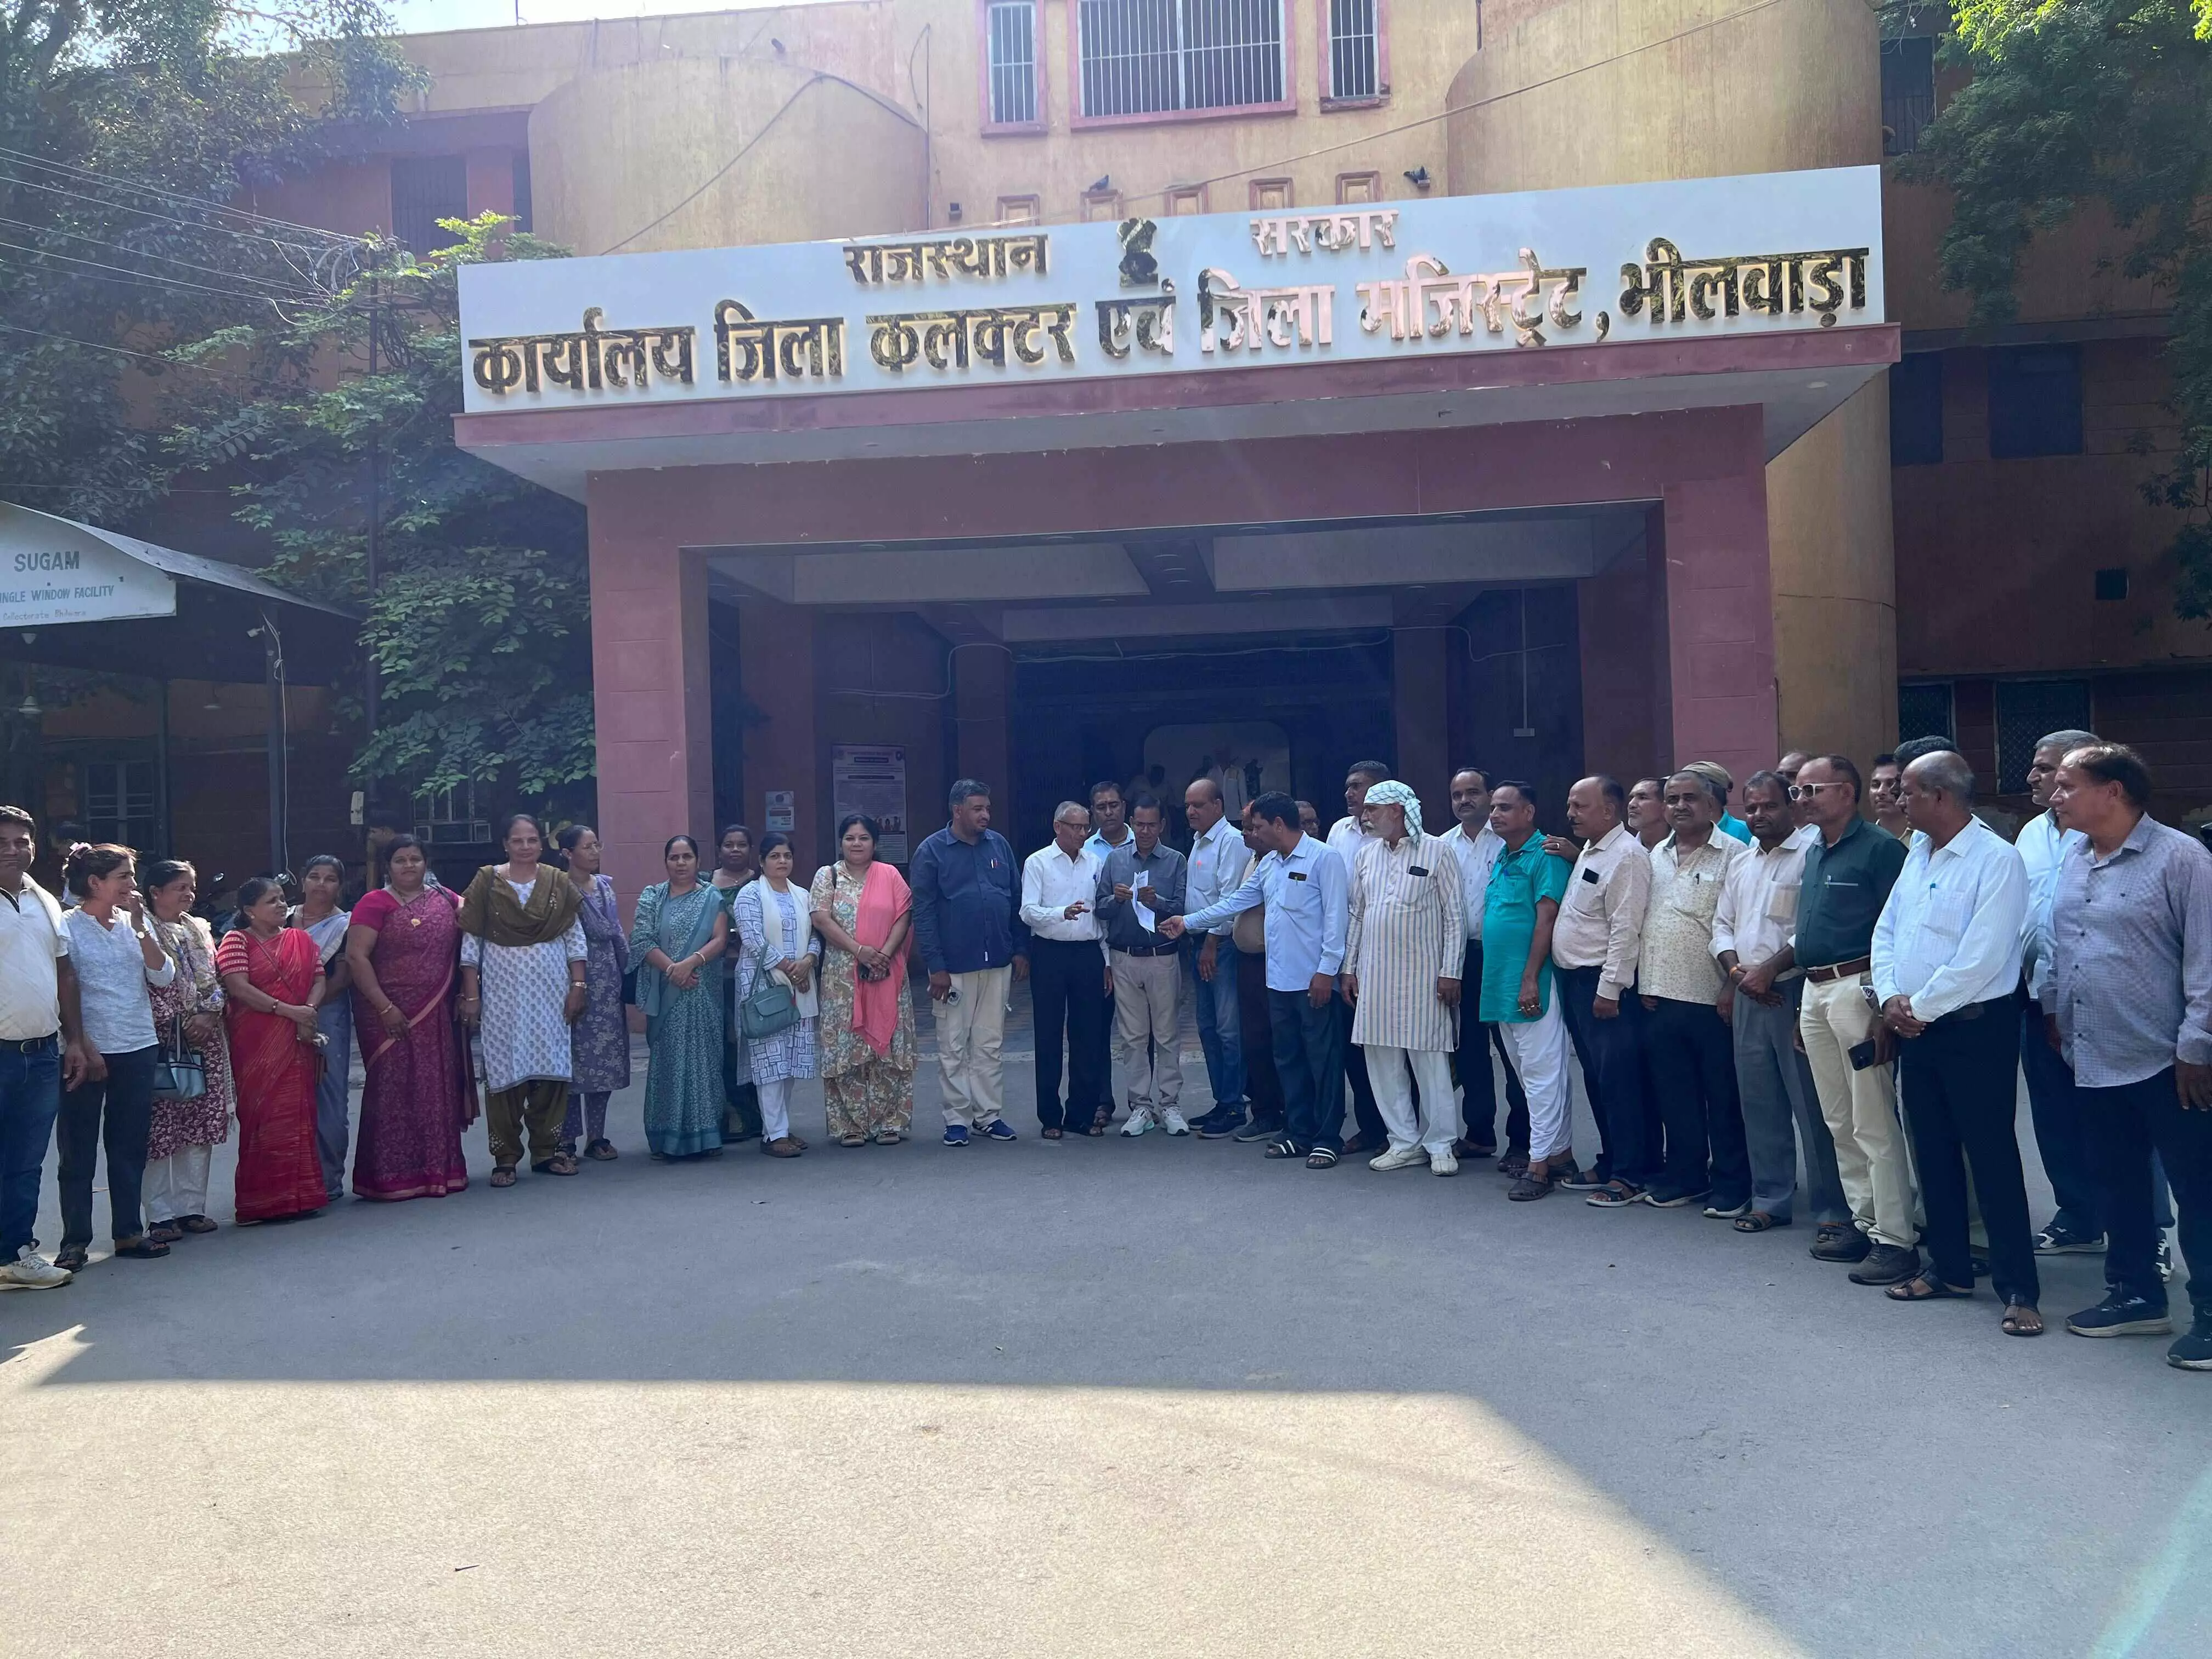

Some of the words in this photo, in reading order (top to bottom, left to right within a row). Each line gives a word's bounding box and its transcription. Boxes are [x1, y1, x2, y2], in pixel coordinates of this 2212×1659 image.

[843, 234, 1048, 284] राजस्थान
[1250, 209, 1398, 255] सरकार
[469, 307, 695, 394] कार्यालय
[714, 299, 844, 381] जिला
[865, 302, 1077, 371] कलक्टर
[1094, 278, 1176, 358] एवं
[1198, 267, 1335, 352] जिला
[1620, 236, 1870, 329] भीलवाड़ा
[14, 550, 80, 572] SUGAM
[31, 589, 71, 601] WINDOW
[74, 585, 114, 599] FACILITY
